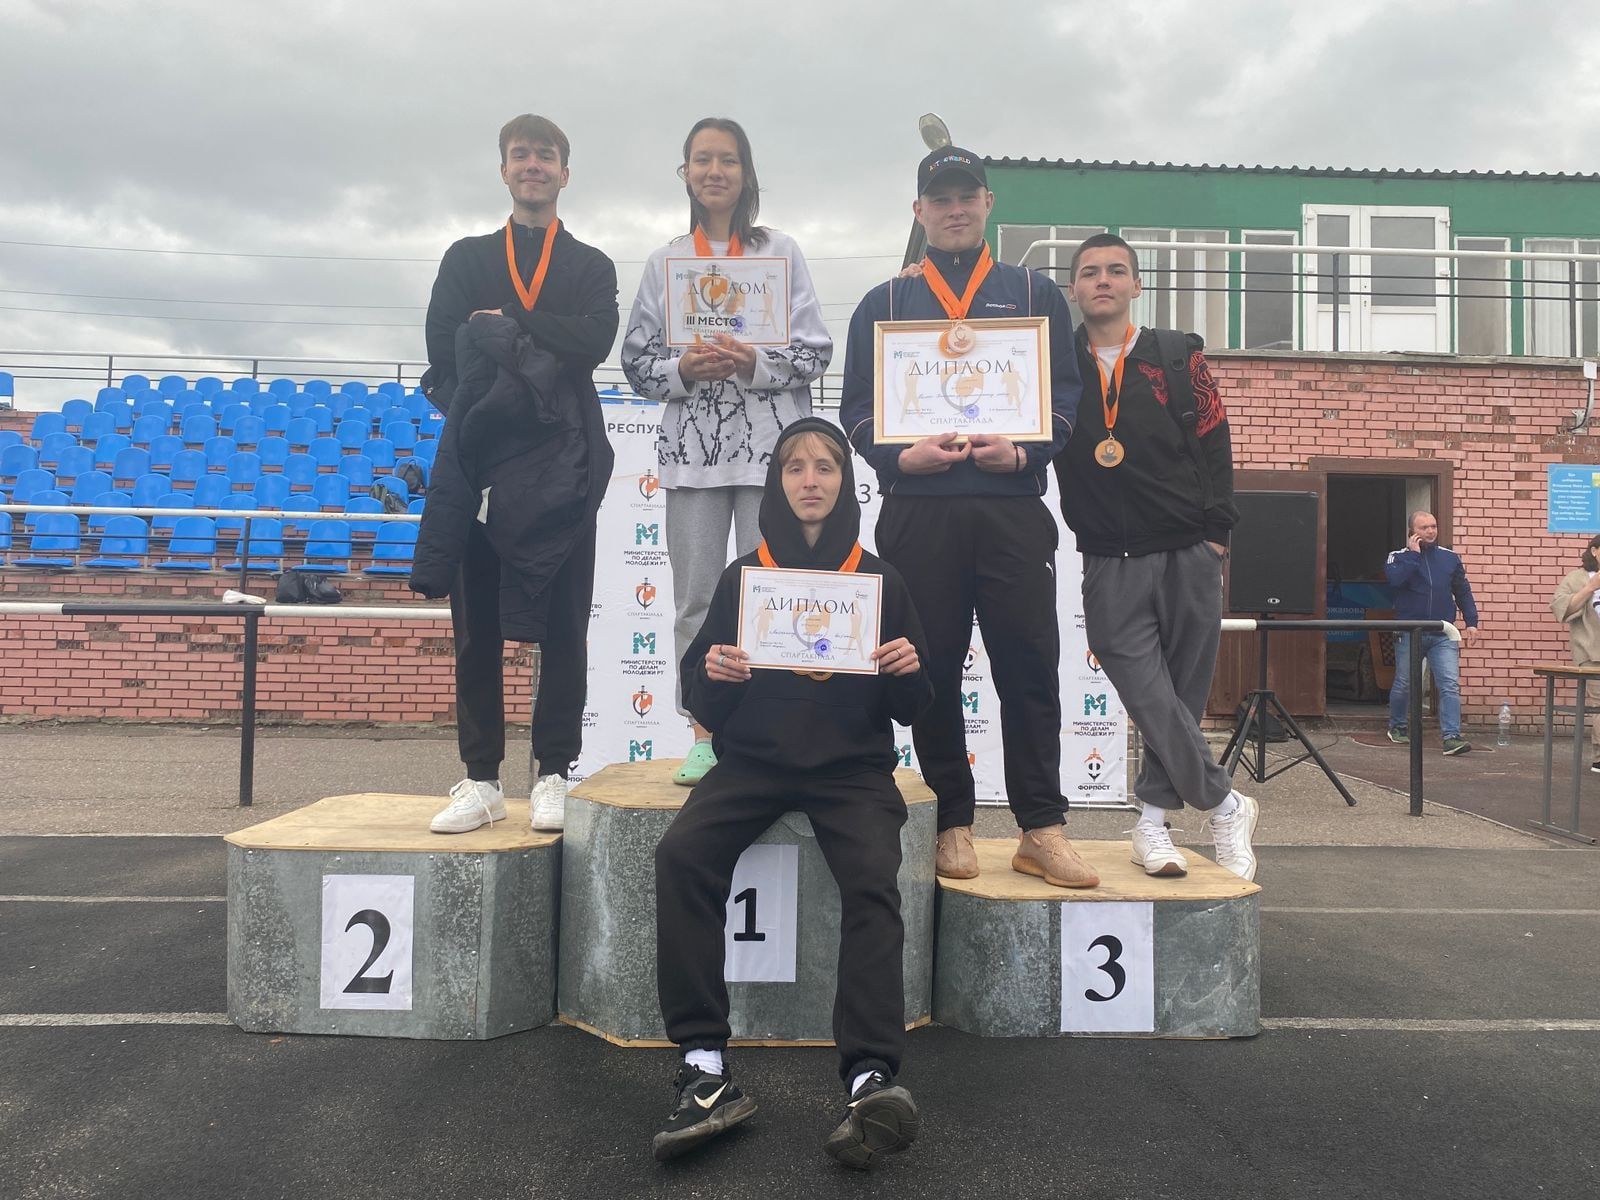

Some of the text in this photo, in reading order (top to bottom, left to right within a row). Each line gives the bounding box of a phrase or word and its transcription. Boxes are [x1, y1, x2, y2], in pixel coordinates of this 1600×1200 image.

[698, 316, 738, 327] МЕСТО
[908, 359, 1012, 376] ДИПЛОМ
[764, 597, 855, 615] ДИПЛОМ
[734, 888, 765, 941] 1
[342, 909, 394, 994] 2
[1084, 935, 1126, 1001] 3
